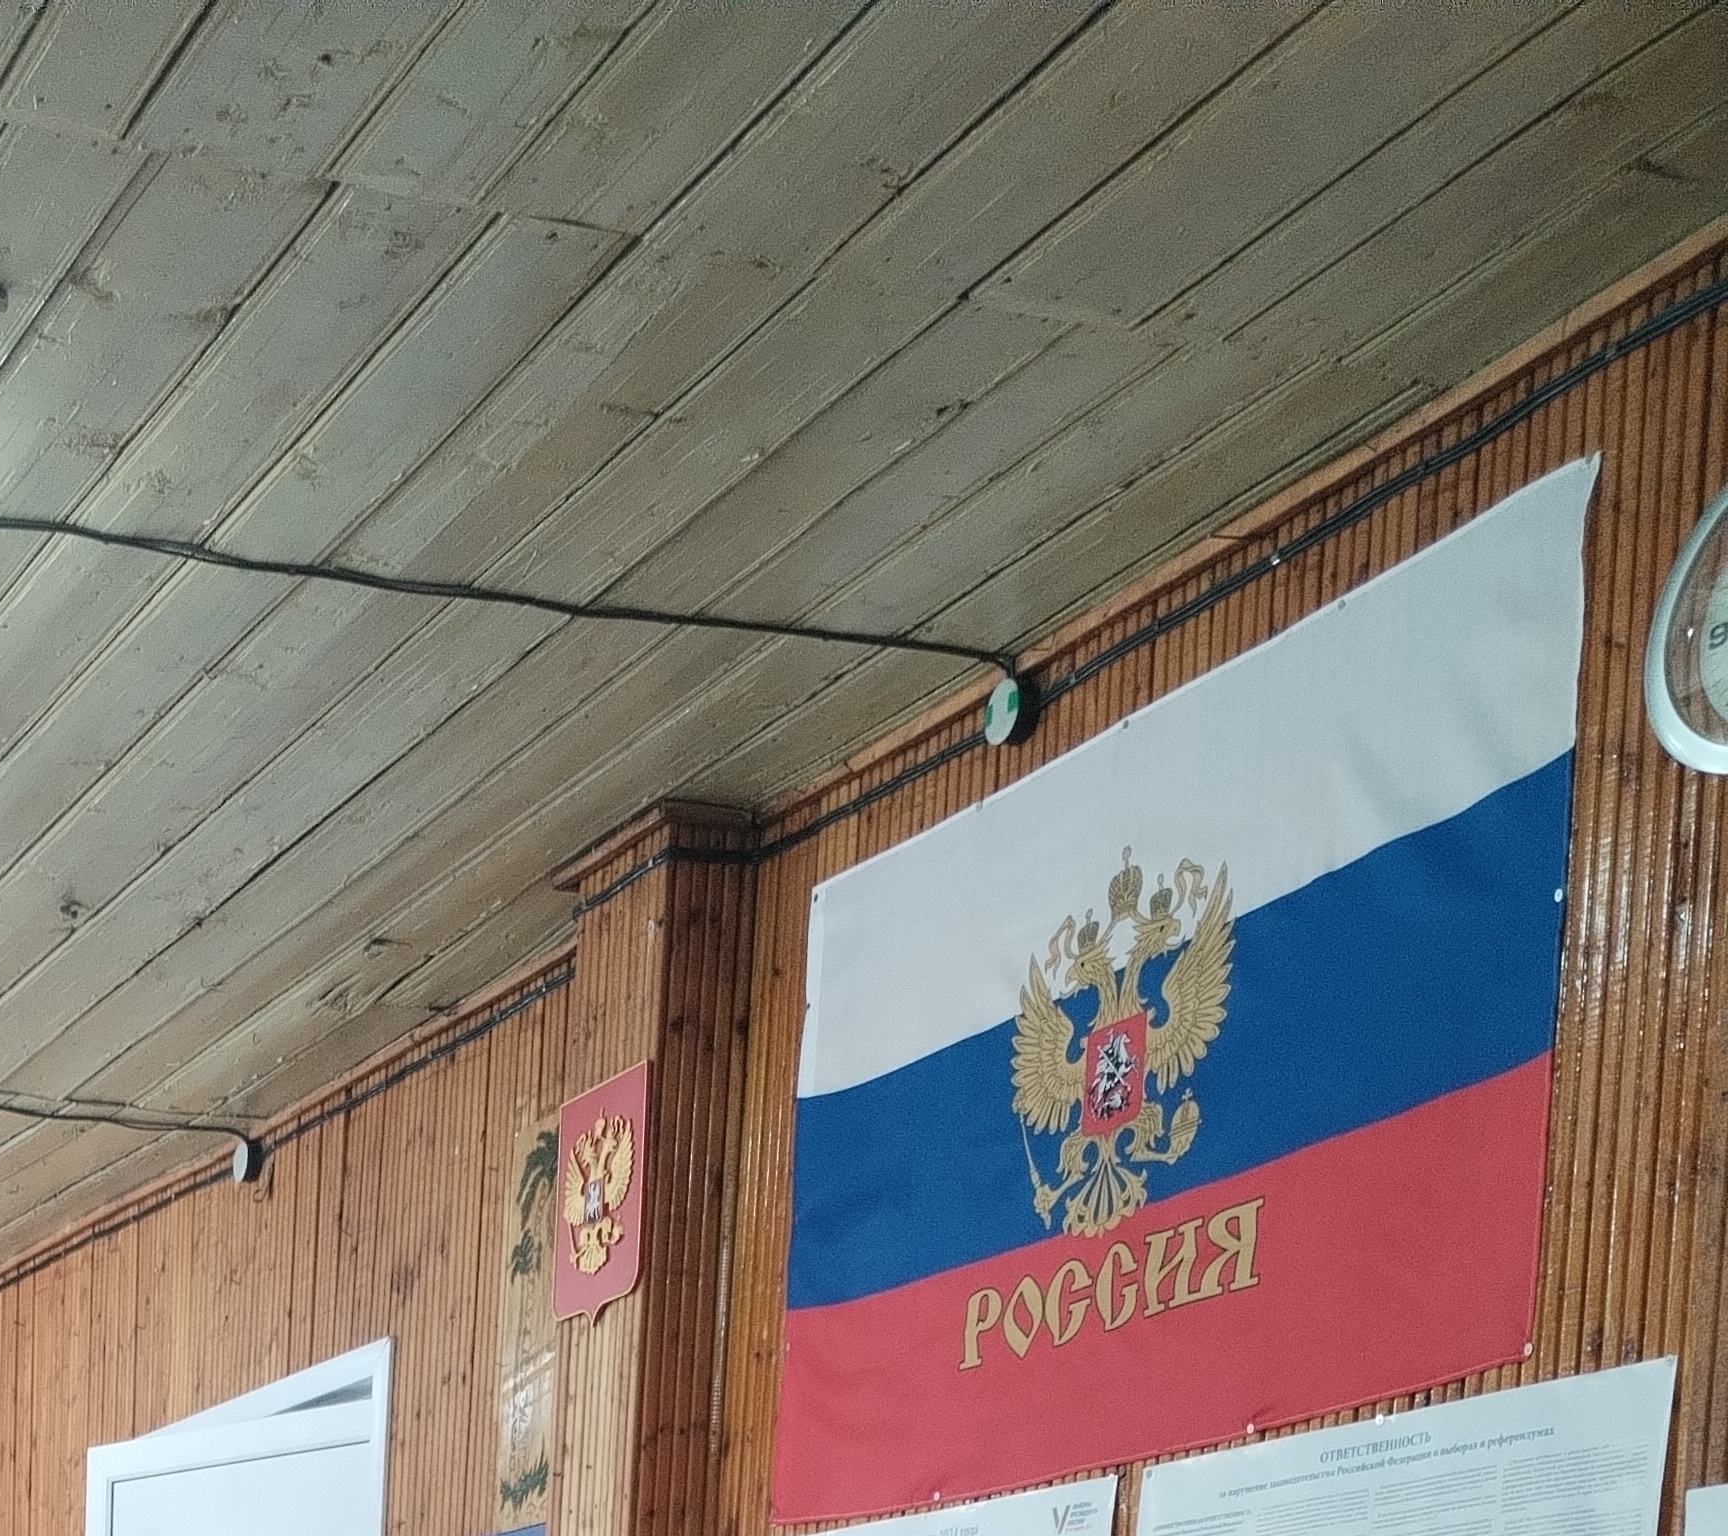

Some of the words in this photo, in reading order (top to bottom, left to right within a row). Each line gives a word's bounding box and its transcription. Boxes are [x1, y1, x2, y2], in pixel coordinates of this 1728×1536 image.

[958, 1196, 1265, 1371] РОССИЯ
[1319, 1431, 1432, 1464] ОТВЕТСТВЕННОСТЬ
[1337, 1457, 1385, 1477] Российской
